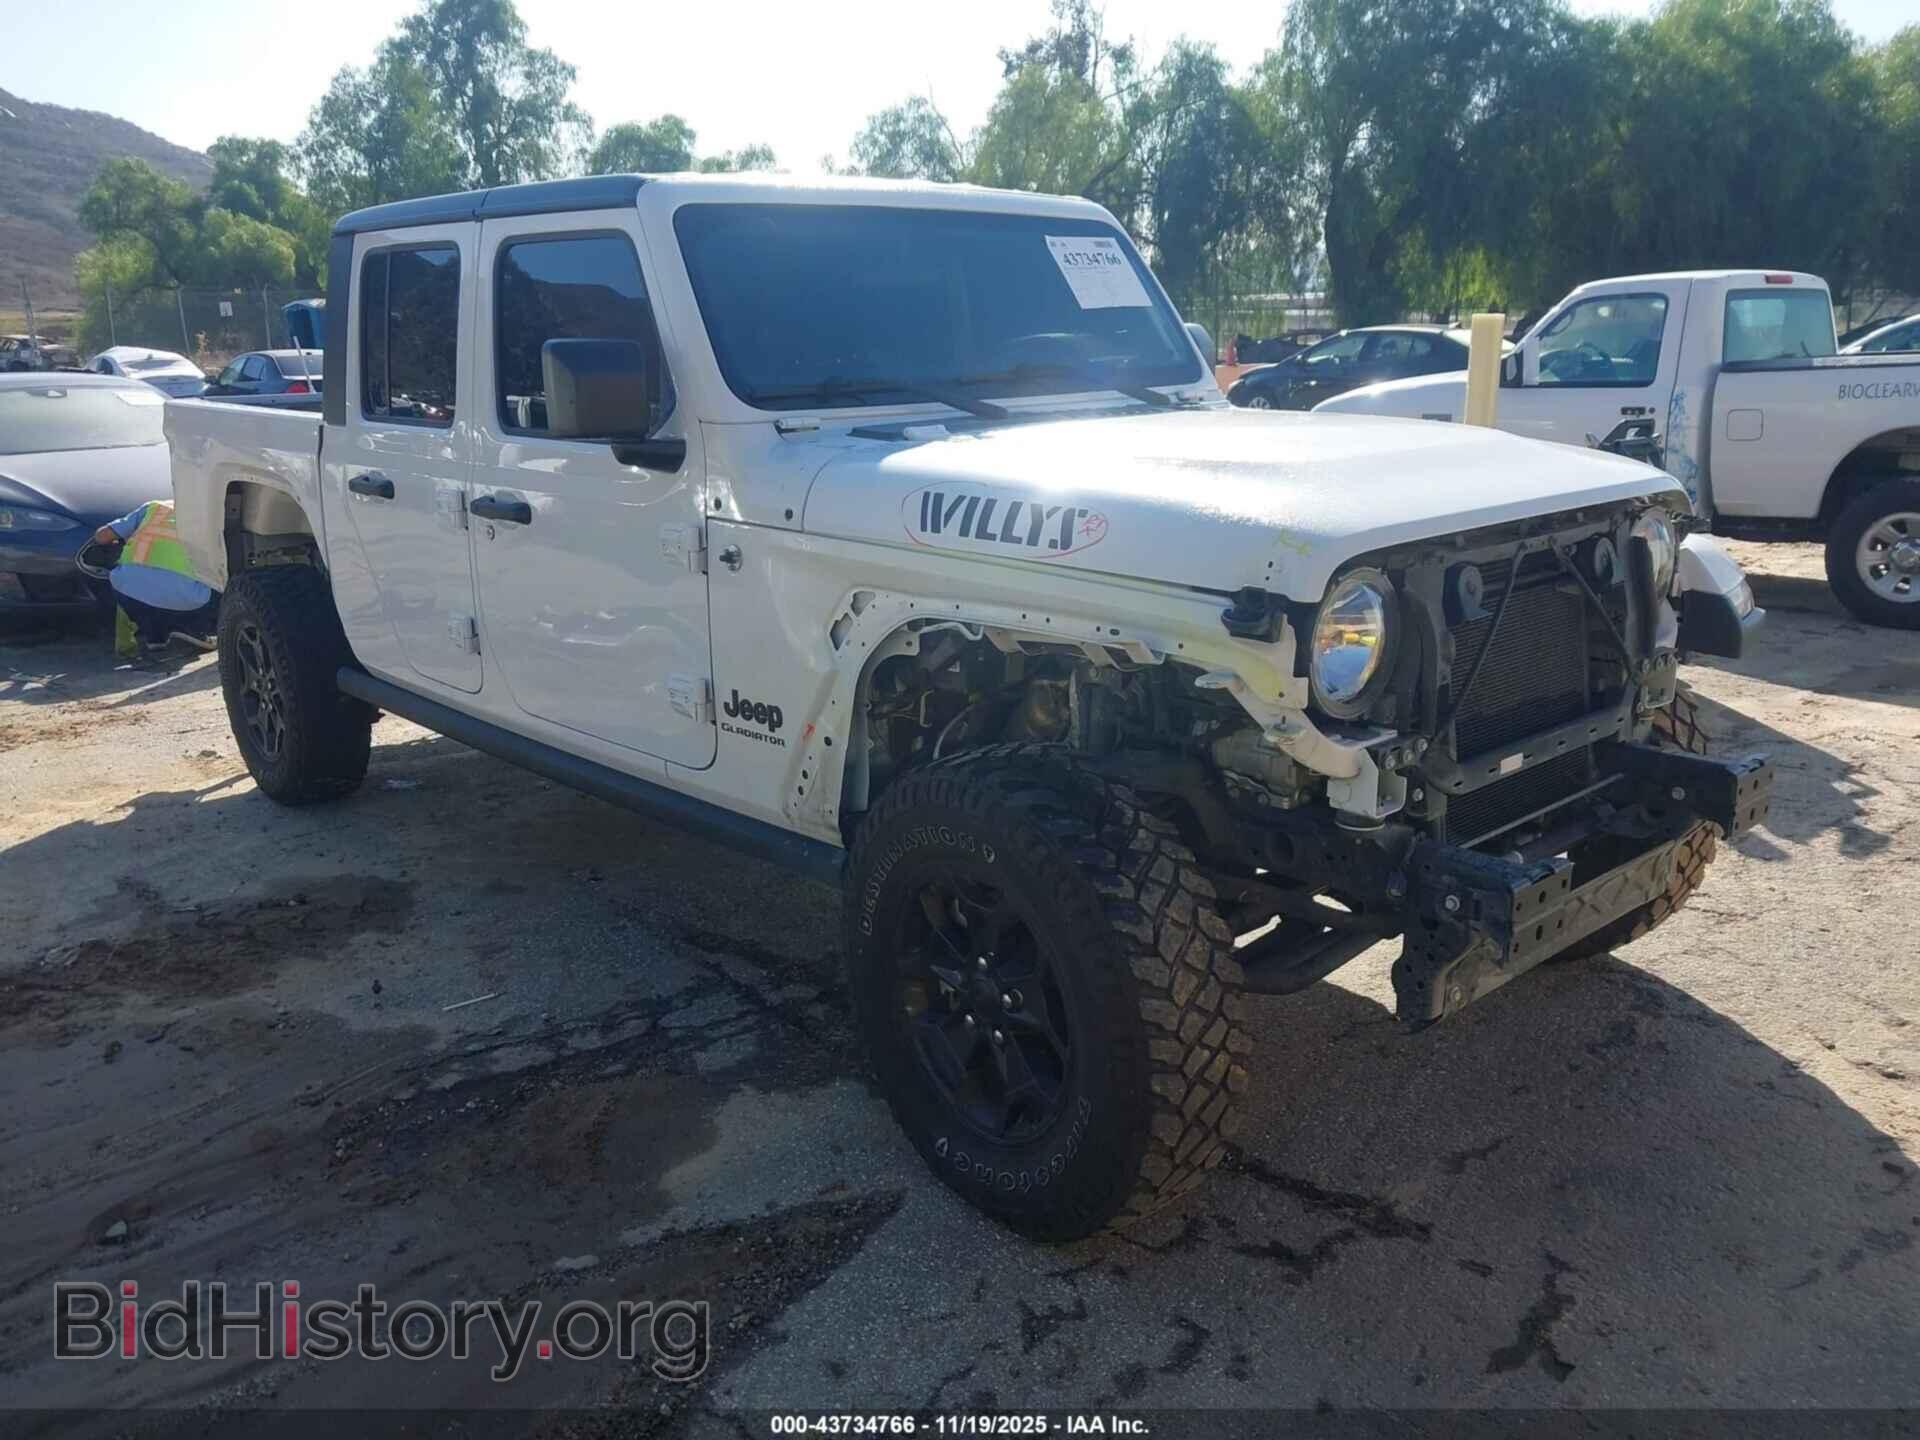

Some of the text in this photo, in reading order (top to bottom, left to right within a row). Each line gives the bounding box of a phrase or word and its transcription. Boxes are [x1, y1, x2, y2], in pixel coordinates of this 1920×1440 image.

[1063, 252, 1121, 266] 43734766
[920, 491, 1089, 551] WILLYS
[723, 688, 784, 733] Jeep
[721, 722, 786, 748] GLADIATOR
[858, 824, 976, 936] DESTINATION
